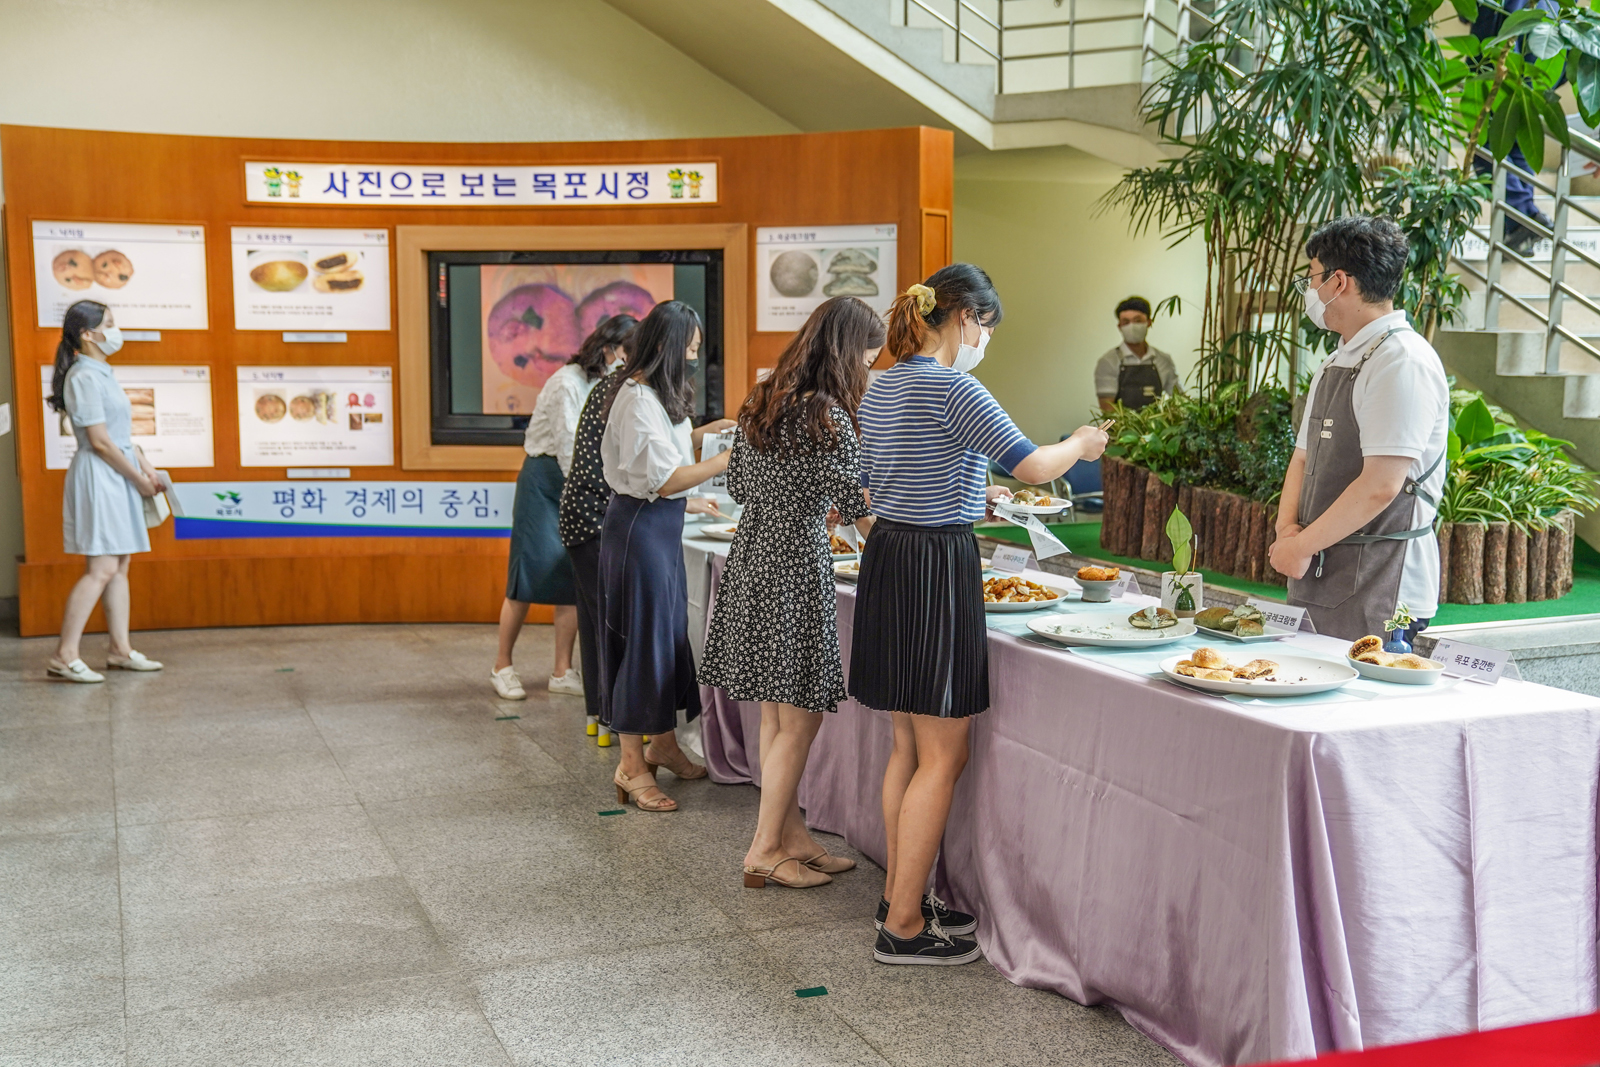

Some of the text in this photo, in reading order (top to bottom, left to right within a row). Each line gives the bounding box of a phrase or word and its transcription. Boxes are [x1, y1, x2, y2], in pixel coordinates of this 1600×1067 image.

[323, 171, 649, 200] 사진으로 보는 목포시정
[272, 488, 499, 518] 평화 경제의 중심,
[1454, 654, 1470, 666] 목포
[1470, 657, 1496, 673] 중깐빵
